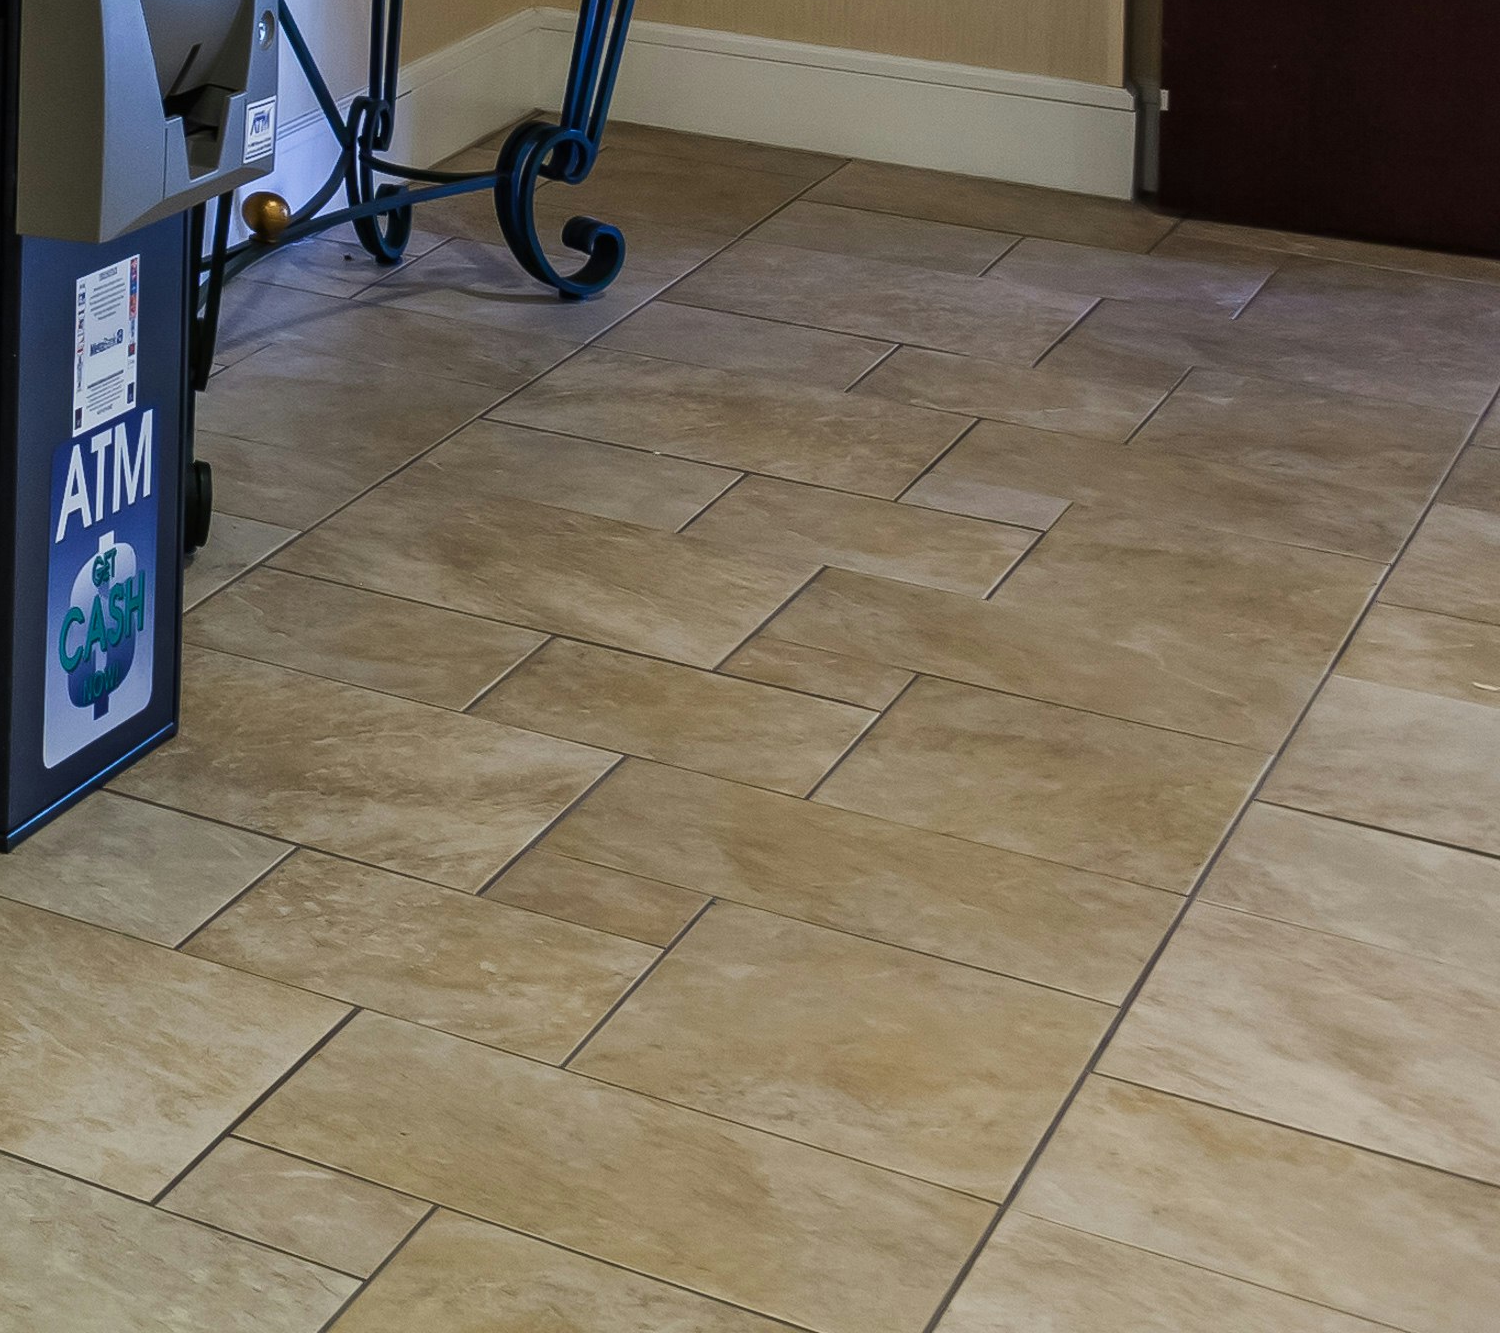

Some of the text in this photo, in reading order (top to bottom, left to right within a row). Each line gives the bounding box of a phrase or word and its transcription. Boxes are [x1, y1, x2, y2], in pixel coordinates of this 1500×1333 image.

[55, 409, 153, 543] ATM
[92, 548, 117, 587] GET
[59, 570, 145, 673] CASH
[83, 670, 120, 703] NOW!
